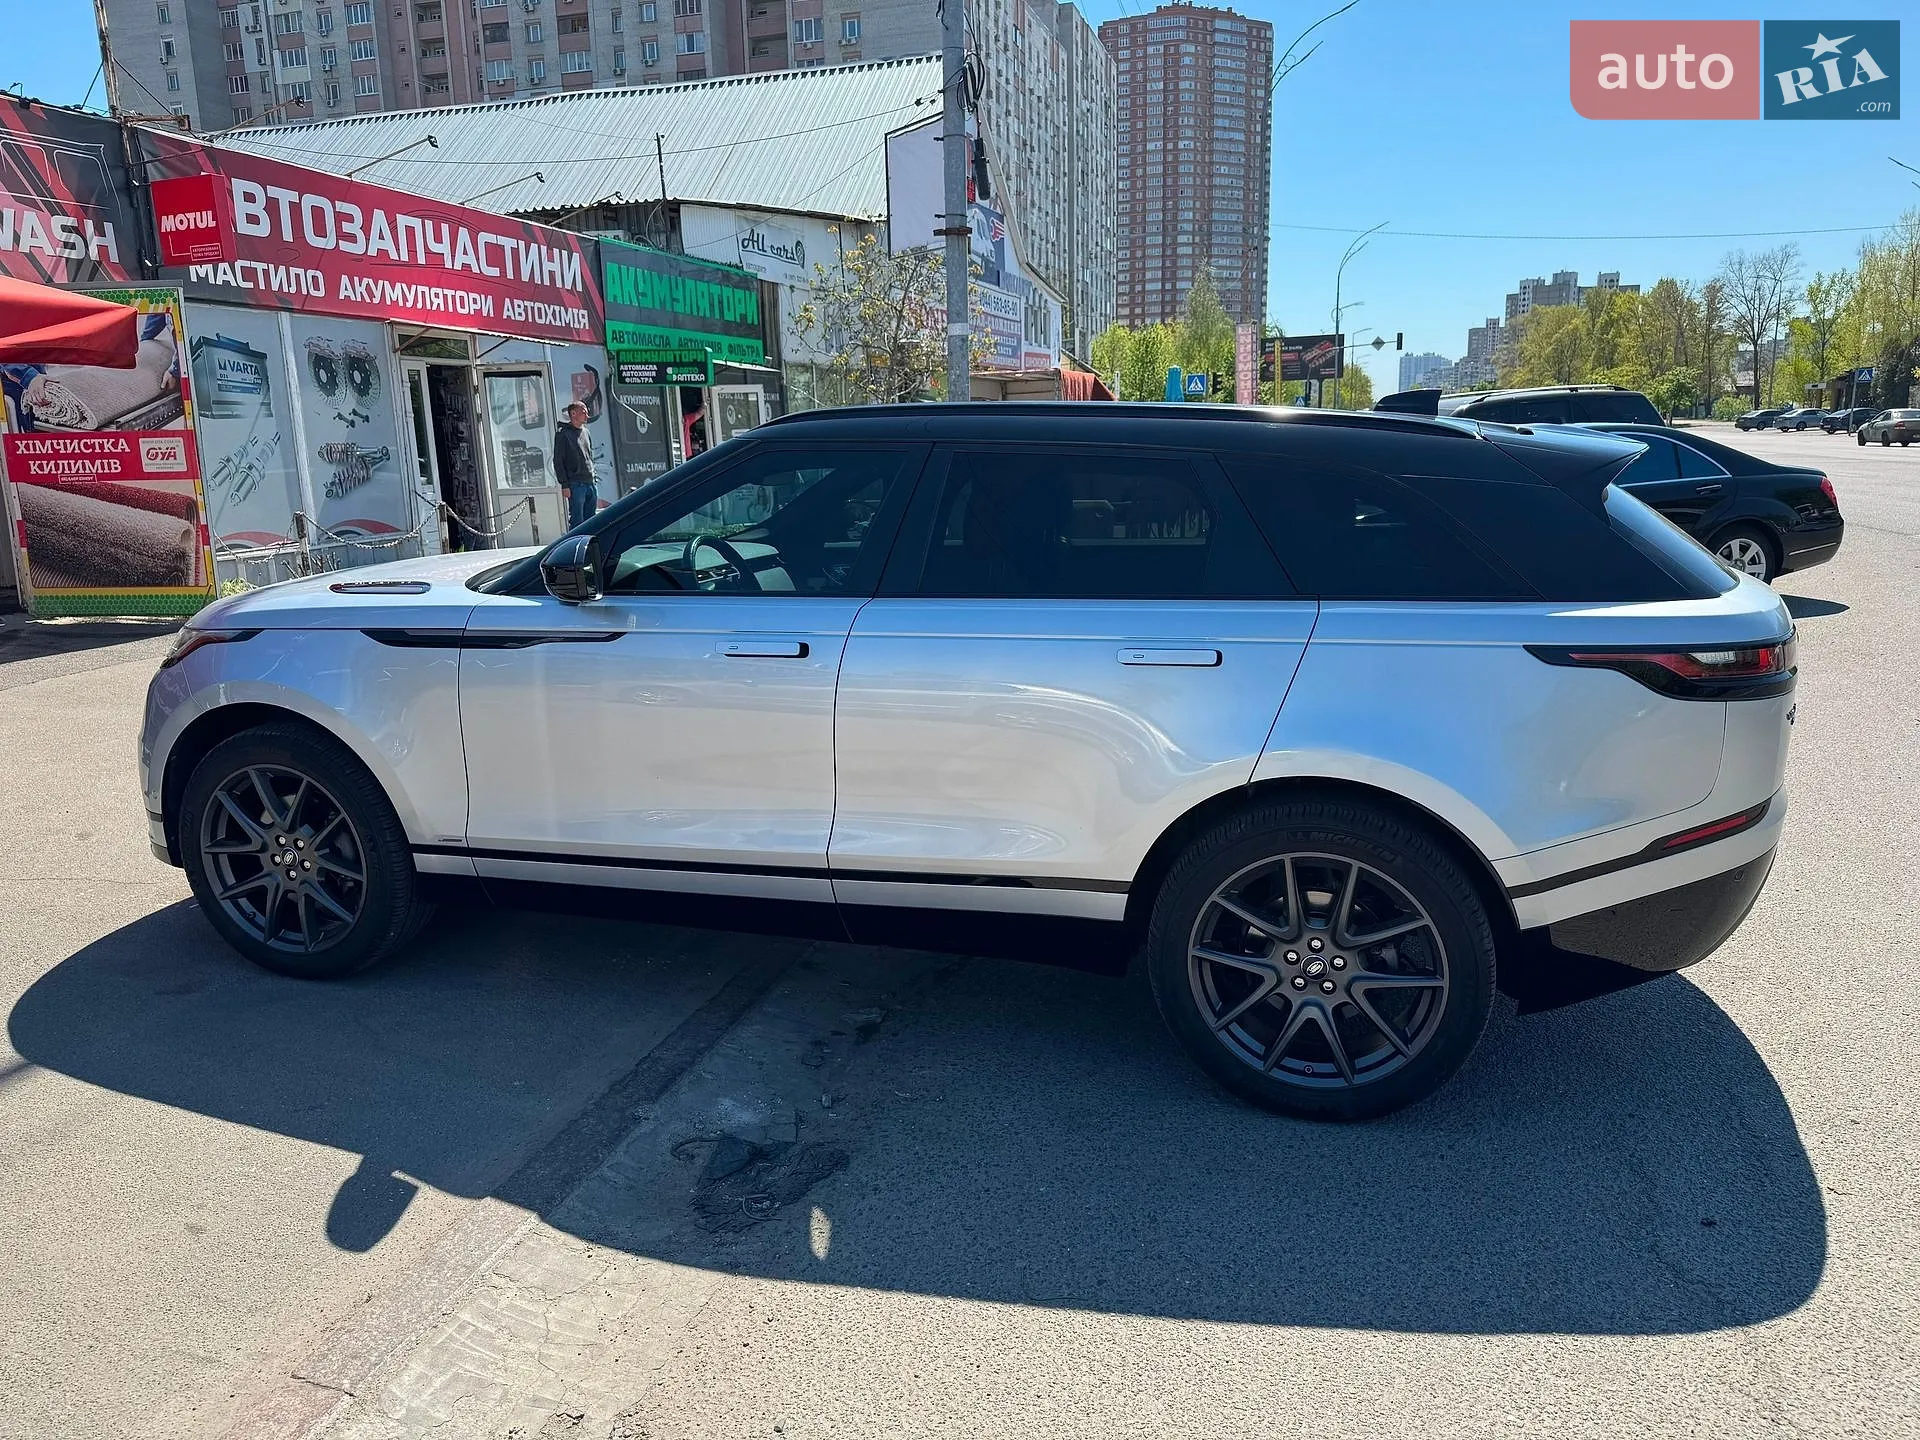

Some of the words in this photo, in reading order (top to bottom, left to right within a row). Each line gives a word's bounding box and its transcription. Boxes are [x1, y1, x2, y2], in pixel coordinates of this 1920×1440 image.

[161, 210, 217, 233] MOTUL
[226, 176, 583, 292] ВТОЗАПЧАСТИНИ
[741, 228, 767, 253] All
[769, 244, 797, 262] cars
[189, 260, 326, 298] МАСТИЛО
[339, 275, 495, 317] АКУМУЛЯТОРИ
[503, 297, 590, 330] АВТОХІМІЯ
[607, 262, 759, 325] АКУМУЛЯТОРИ
[611, 329, 671, 349] АВТОМАСЛА
[727, 342, 761, 359] ФІЛЬТРА
[227, 359, 261, 377] VARTA
[619, 350, 706, 363] АКУМУЛЯТОРИ
[15, 437, 131, 455] ХІМЧИСТКА
[29, 458, 122, 475] КИЛИМІВ
[626, 462, 667, 473] ЗАПЧАСТИНИ
